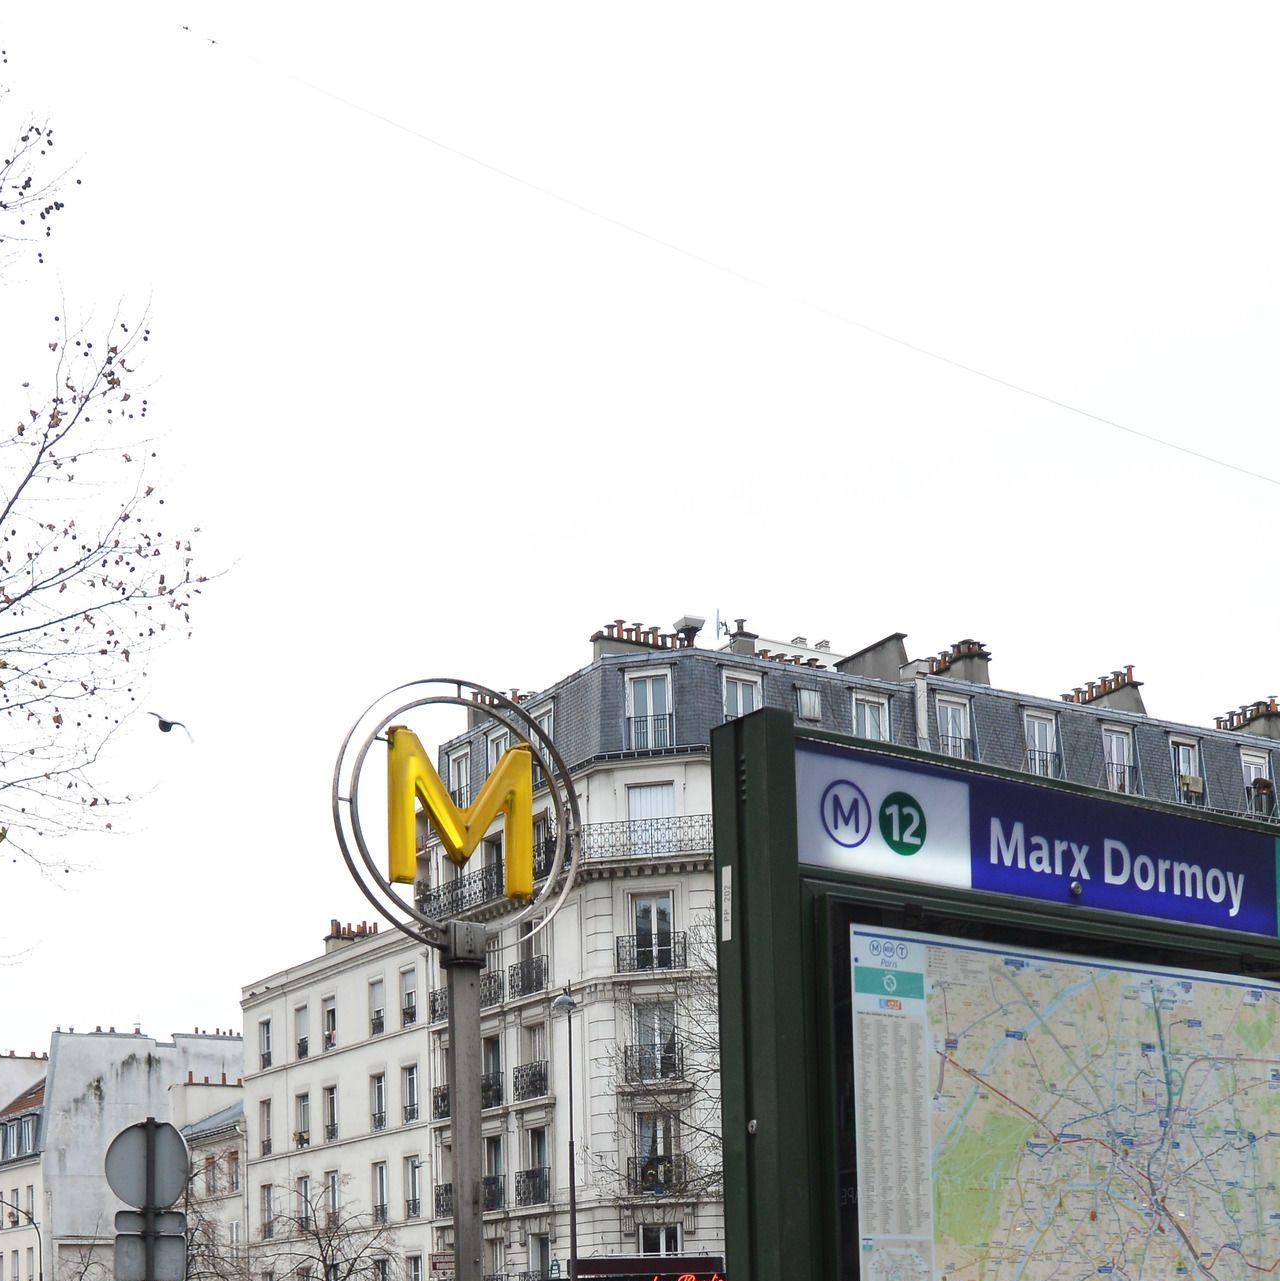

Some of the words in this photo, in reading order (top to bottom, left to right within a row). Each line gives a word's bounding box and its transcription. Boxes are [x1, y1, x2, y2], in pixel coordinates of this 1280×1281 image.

[387, 725, 533, 900] M
[833, 794, 860, 834] M
[885, 804, 921, 845] 12
[990, 817, 1091, 880] Marx
[1104, 838, 1245, 917] Dormoy
[880, 957, 898, 968] Paris
